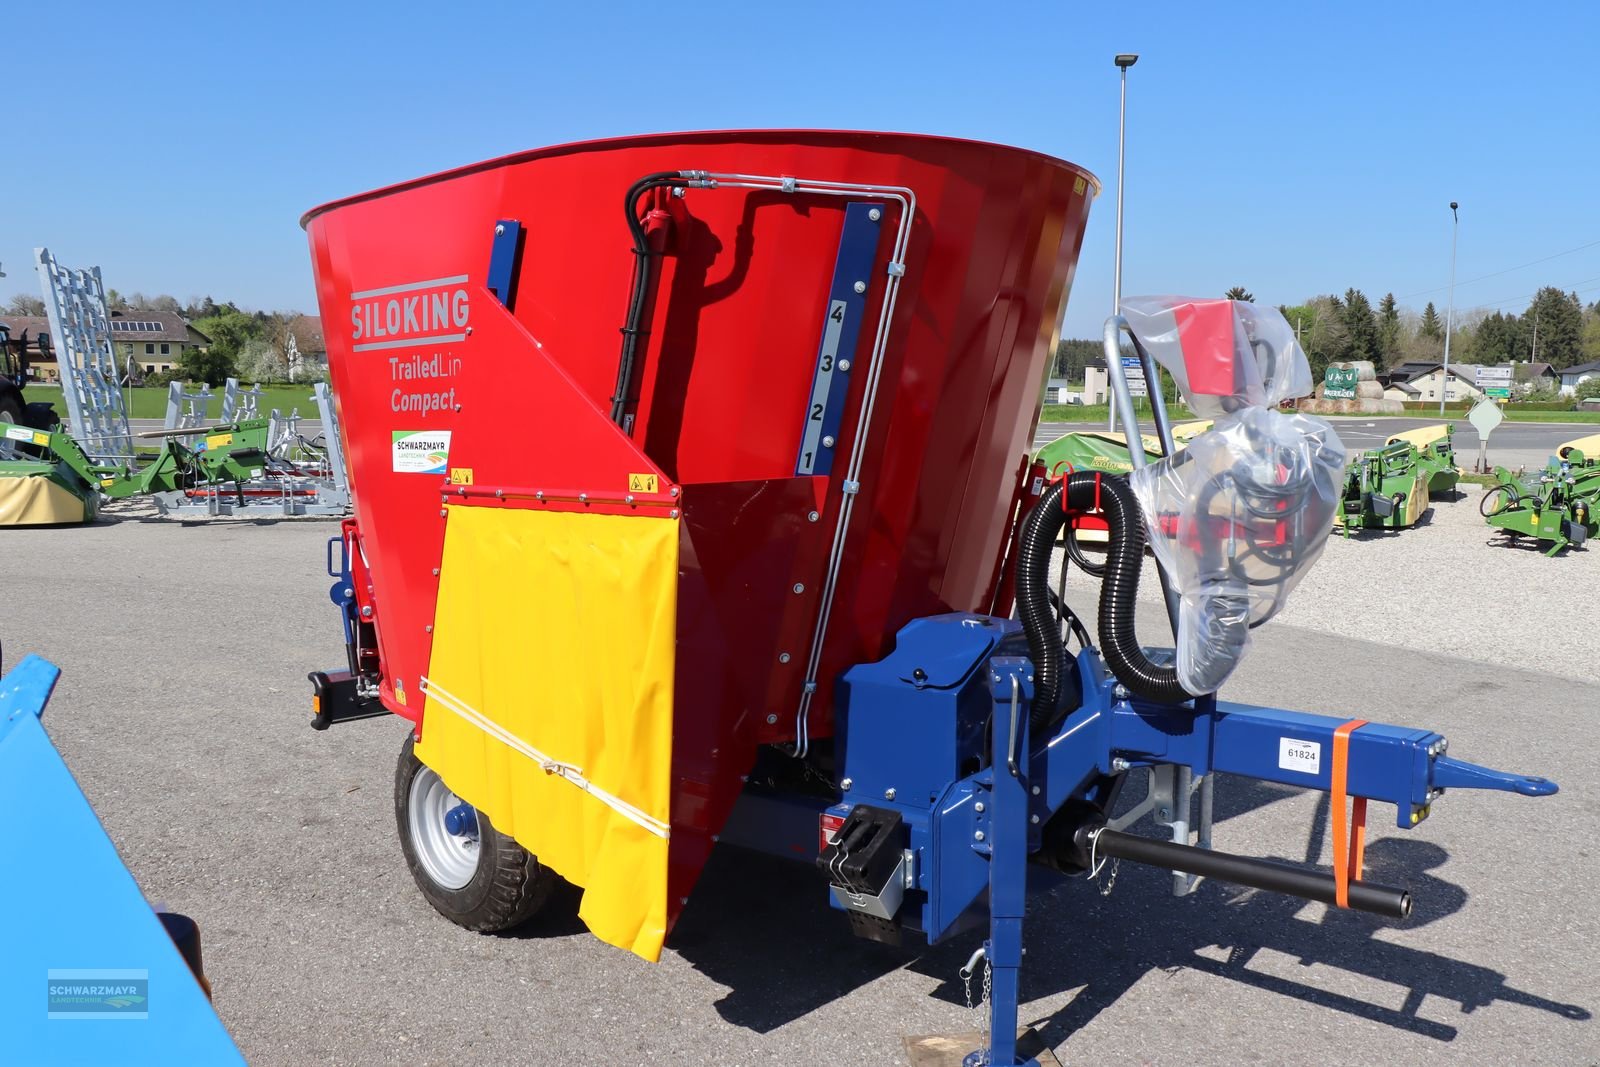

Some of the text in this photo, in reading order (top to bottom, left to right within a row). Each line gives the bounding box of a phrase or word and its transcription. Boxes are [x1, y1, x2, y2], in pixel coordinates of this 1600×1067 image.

[352, 289, 469, 340] SILOKING
[830, 305, 843, 323] 4
[820, 355, 833, 372] 3
[391, 387, 455, 417] Compact
[811, 403, 824, 421] 2
[397, 441, 445, 450] SCHWARZMAYR
[805, 452, 812, 468] 1
[1288, 748, 1315, 760] 61824
